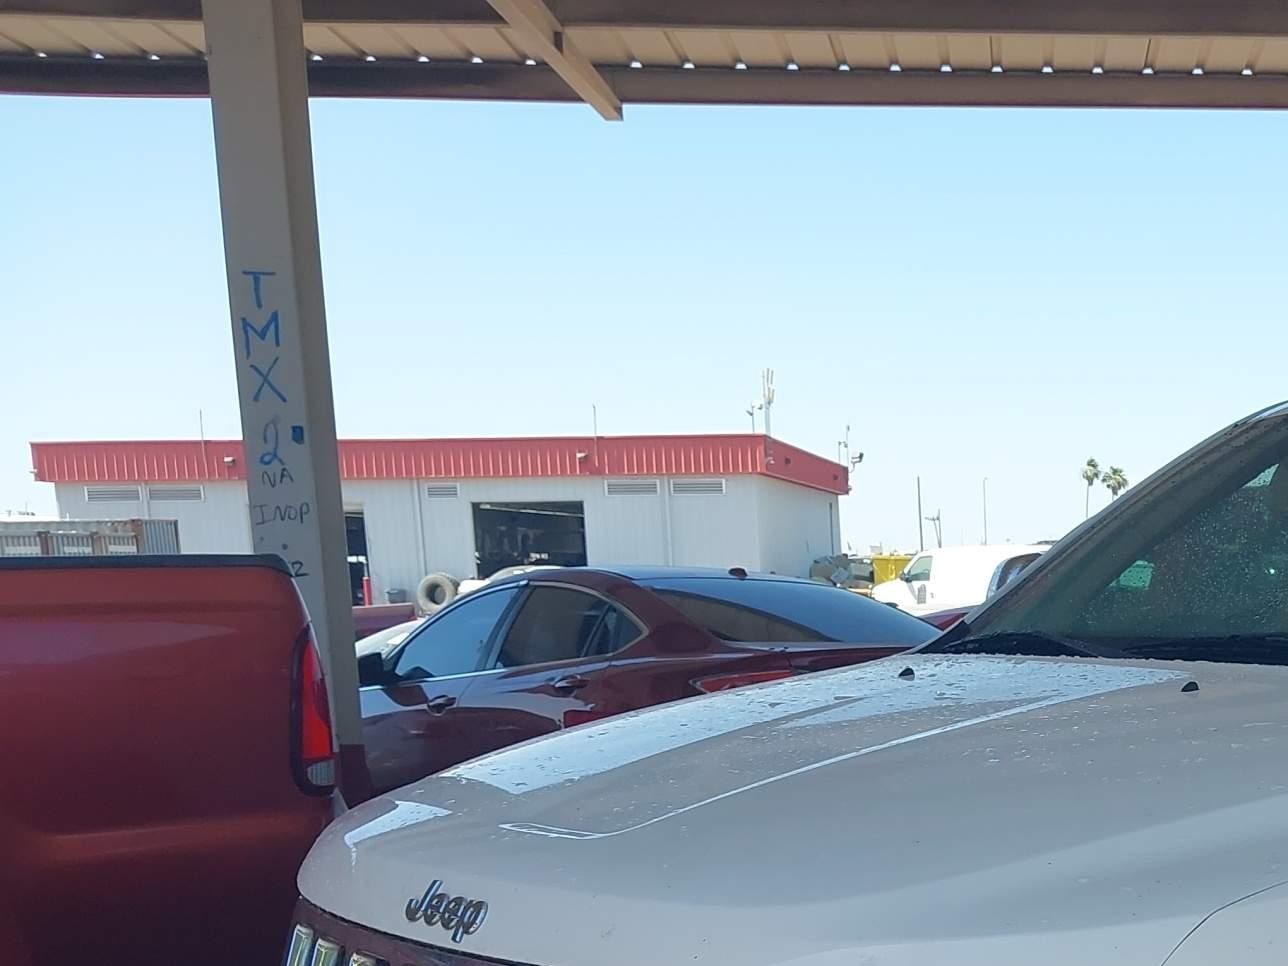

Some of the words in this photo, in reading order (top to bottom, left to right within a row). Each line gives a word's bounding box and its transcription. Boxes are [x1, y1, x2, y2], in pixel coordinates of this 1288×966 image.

[261, 467, 294, 488] NA
[253, 502, 310, 526] INOP
[405, 879, 489, 944] Jeep
